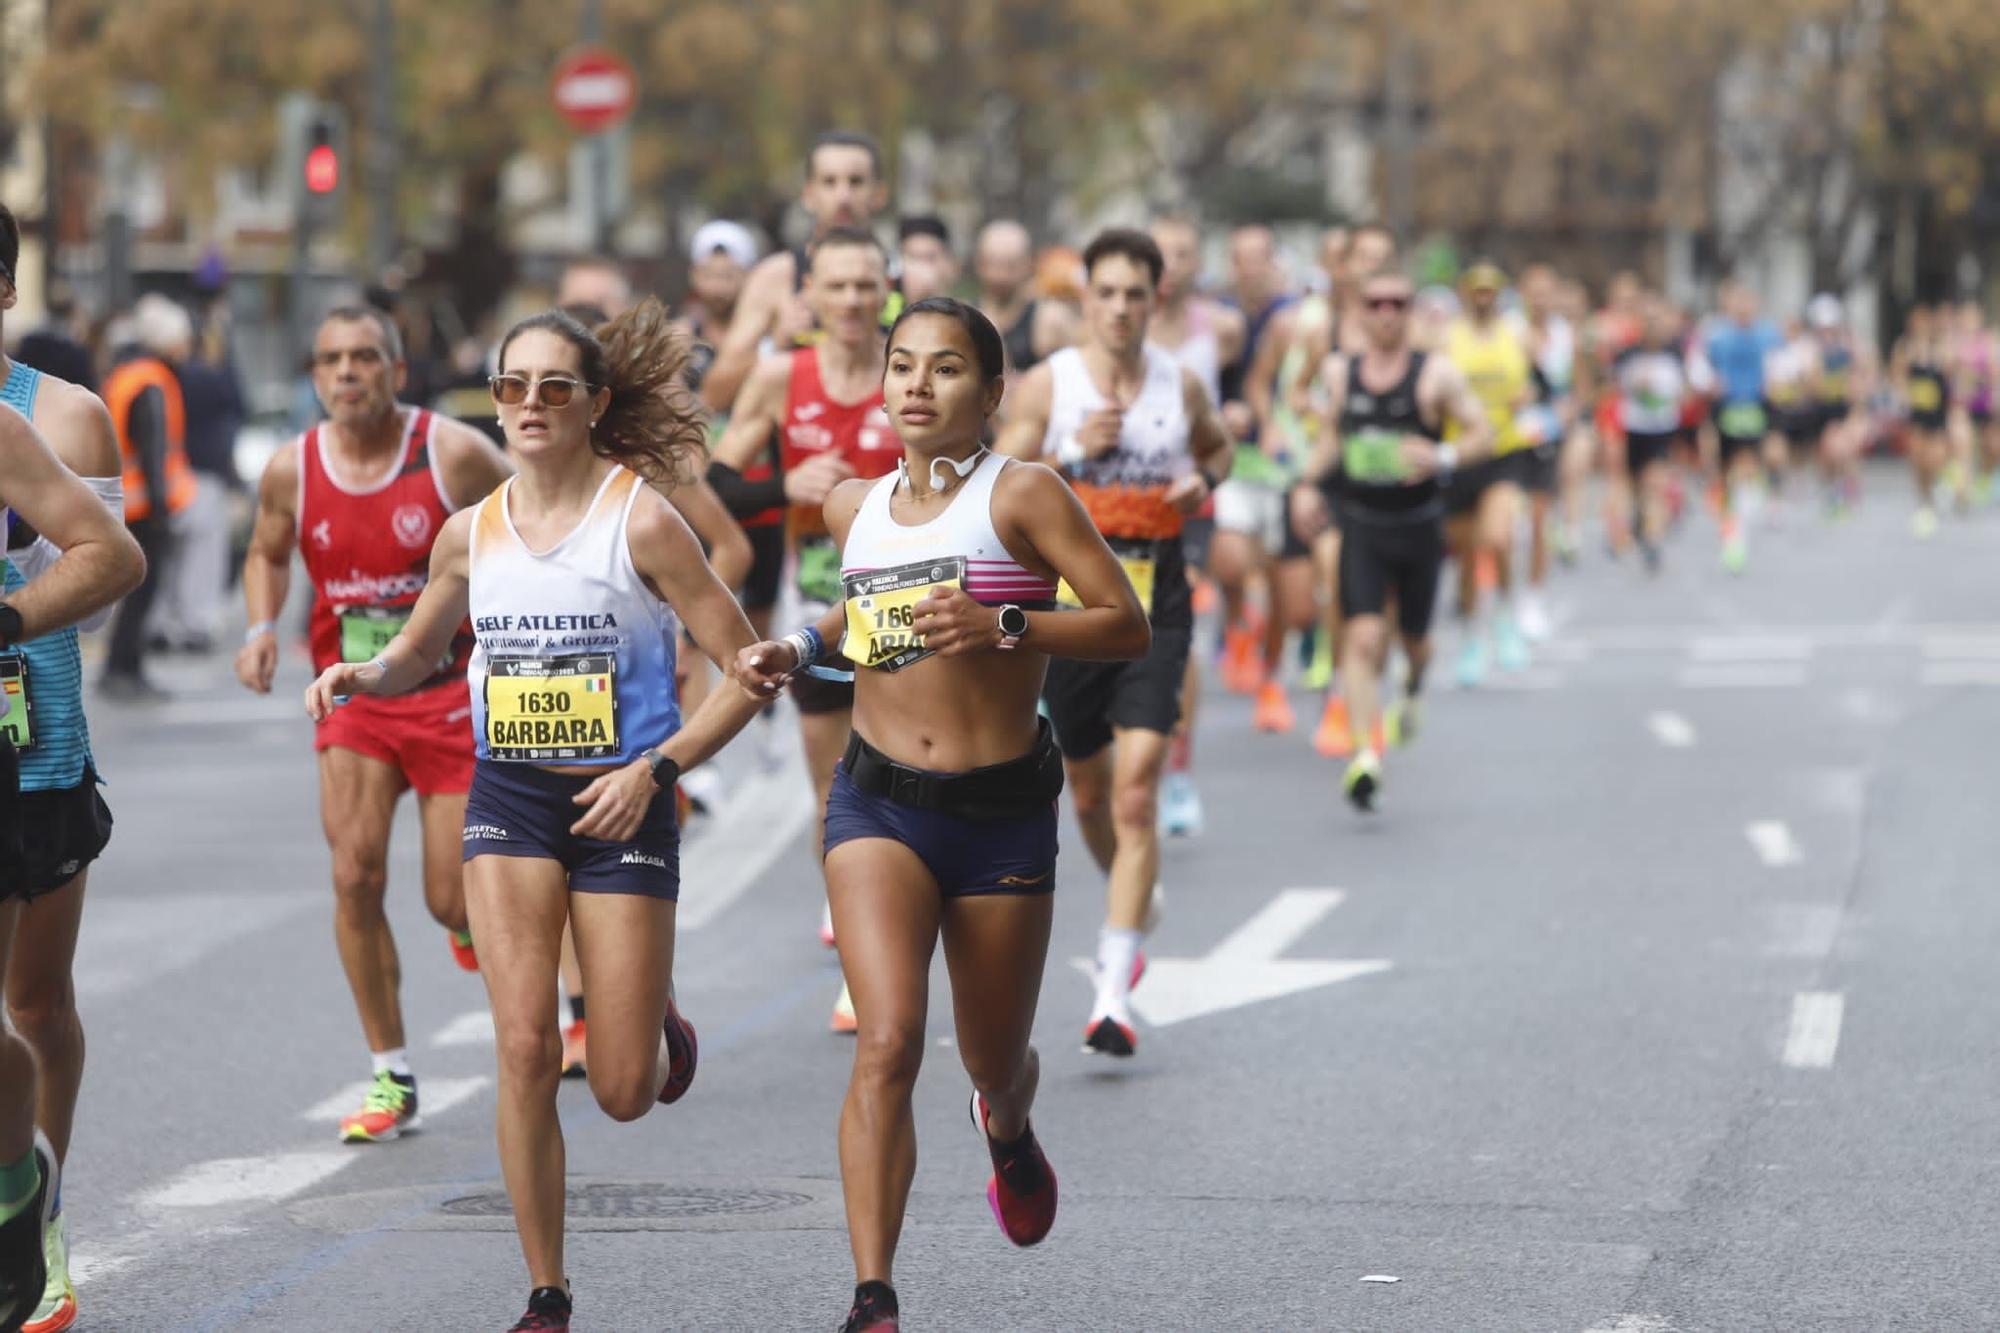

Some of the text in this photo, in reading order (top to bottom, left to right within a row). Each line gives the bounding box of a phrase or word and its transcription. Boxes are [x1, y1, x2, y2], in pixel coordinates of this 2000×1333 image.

[476, 613, 617, 632] SELF ATLETICA
[873, 604, 915, 629] 166
[545, 636, 556, 649] &
[867, 631, 926, 664] ARIA
[518, 691, 571, 713] 1630
[494, 718, 607, 745] BARBARA
